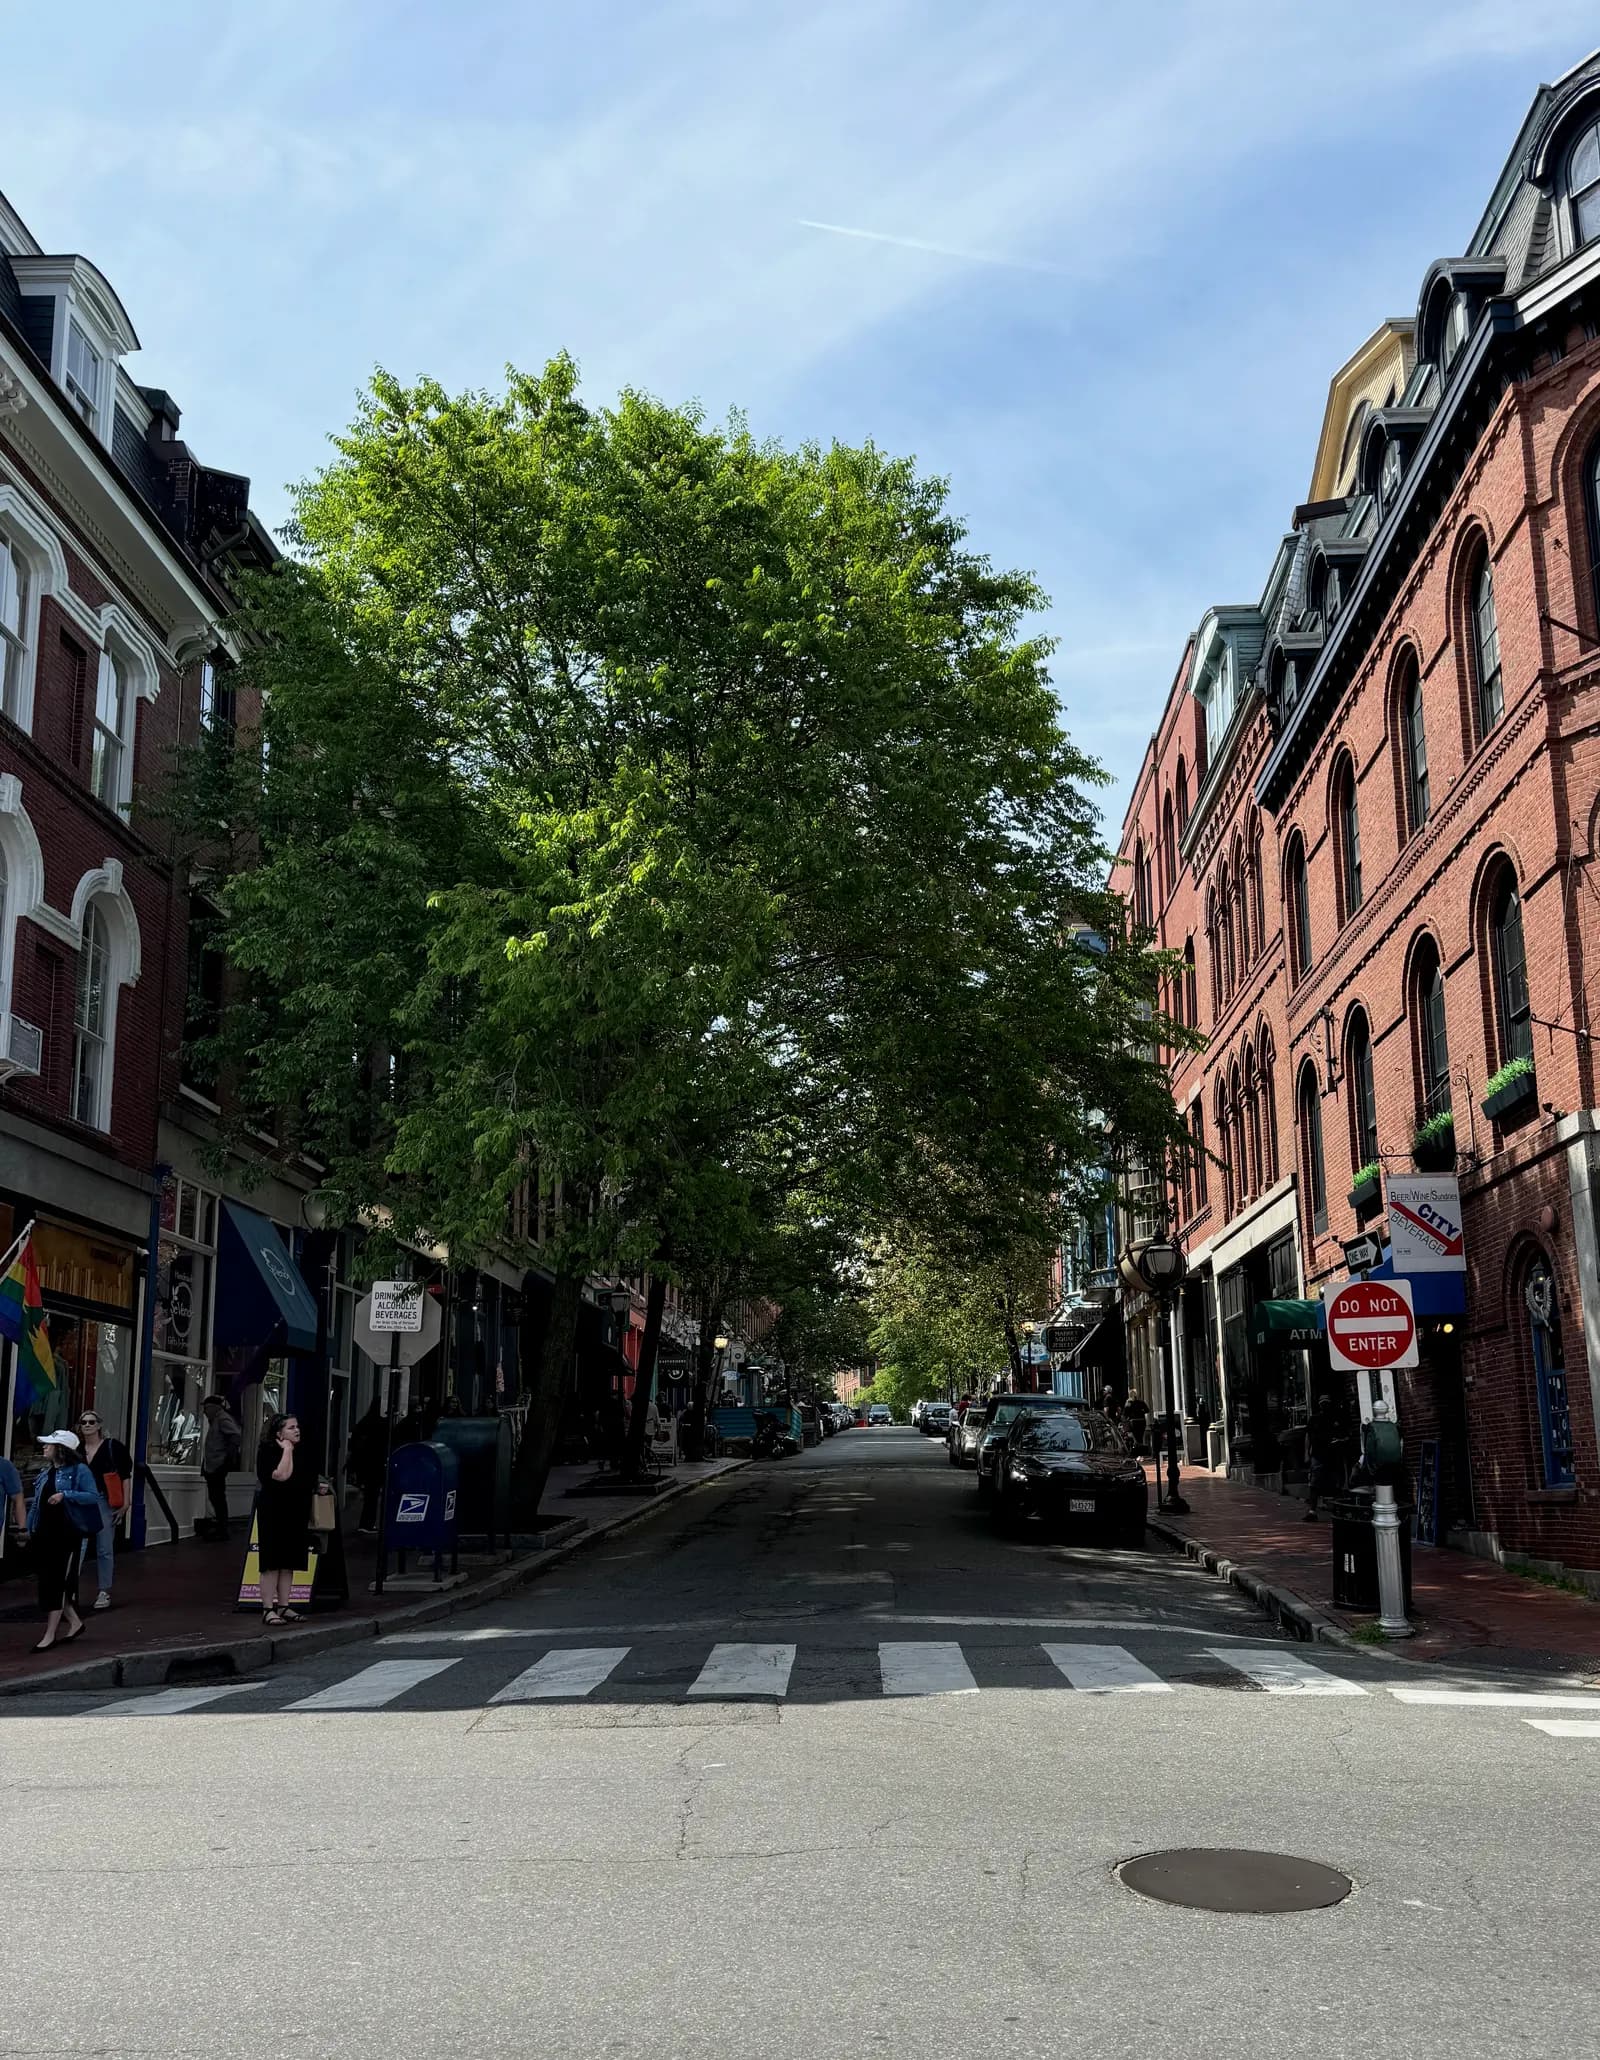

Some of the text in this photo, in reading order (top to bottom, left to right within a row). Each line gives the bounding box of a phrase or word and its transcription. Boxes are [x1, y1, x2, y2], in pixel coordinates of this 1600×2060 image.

[1417, 1203, 1460, 1237] CITY
[1390, 1211, 1446, 1256] BEVERAGE
[1348, 1246, 1370, 1264] ONE WAY
[393, 1283, 404, 1291] NO
[377, 1301, 417, 1310] ALCOHOLIC
[1339, 1298, 1398, 1313] DO NOT
[375, 1310, 417, 1320] BEVERAGES
[1289, 1328, 1323, 1341] ATM
[1348, 1336, 1398, 1351] ENTER
